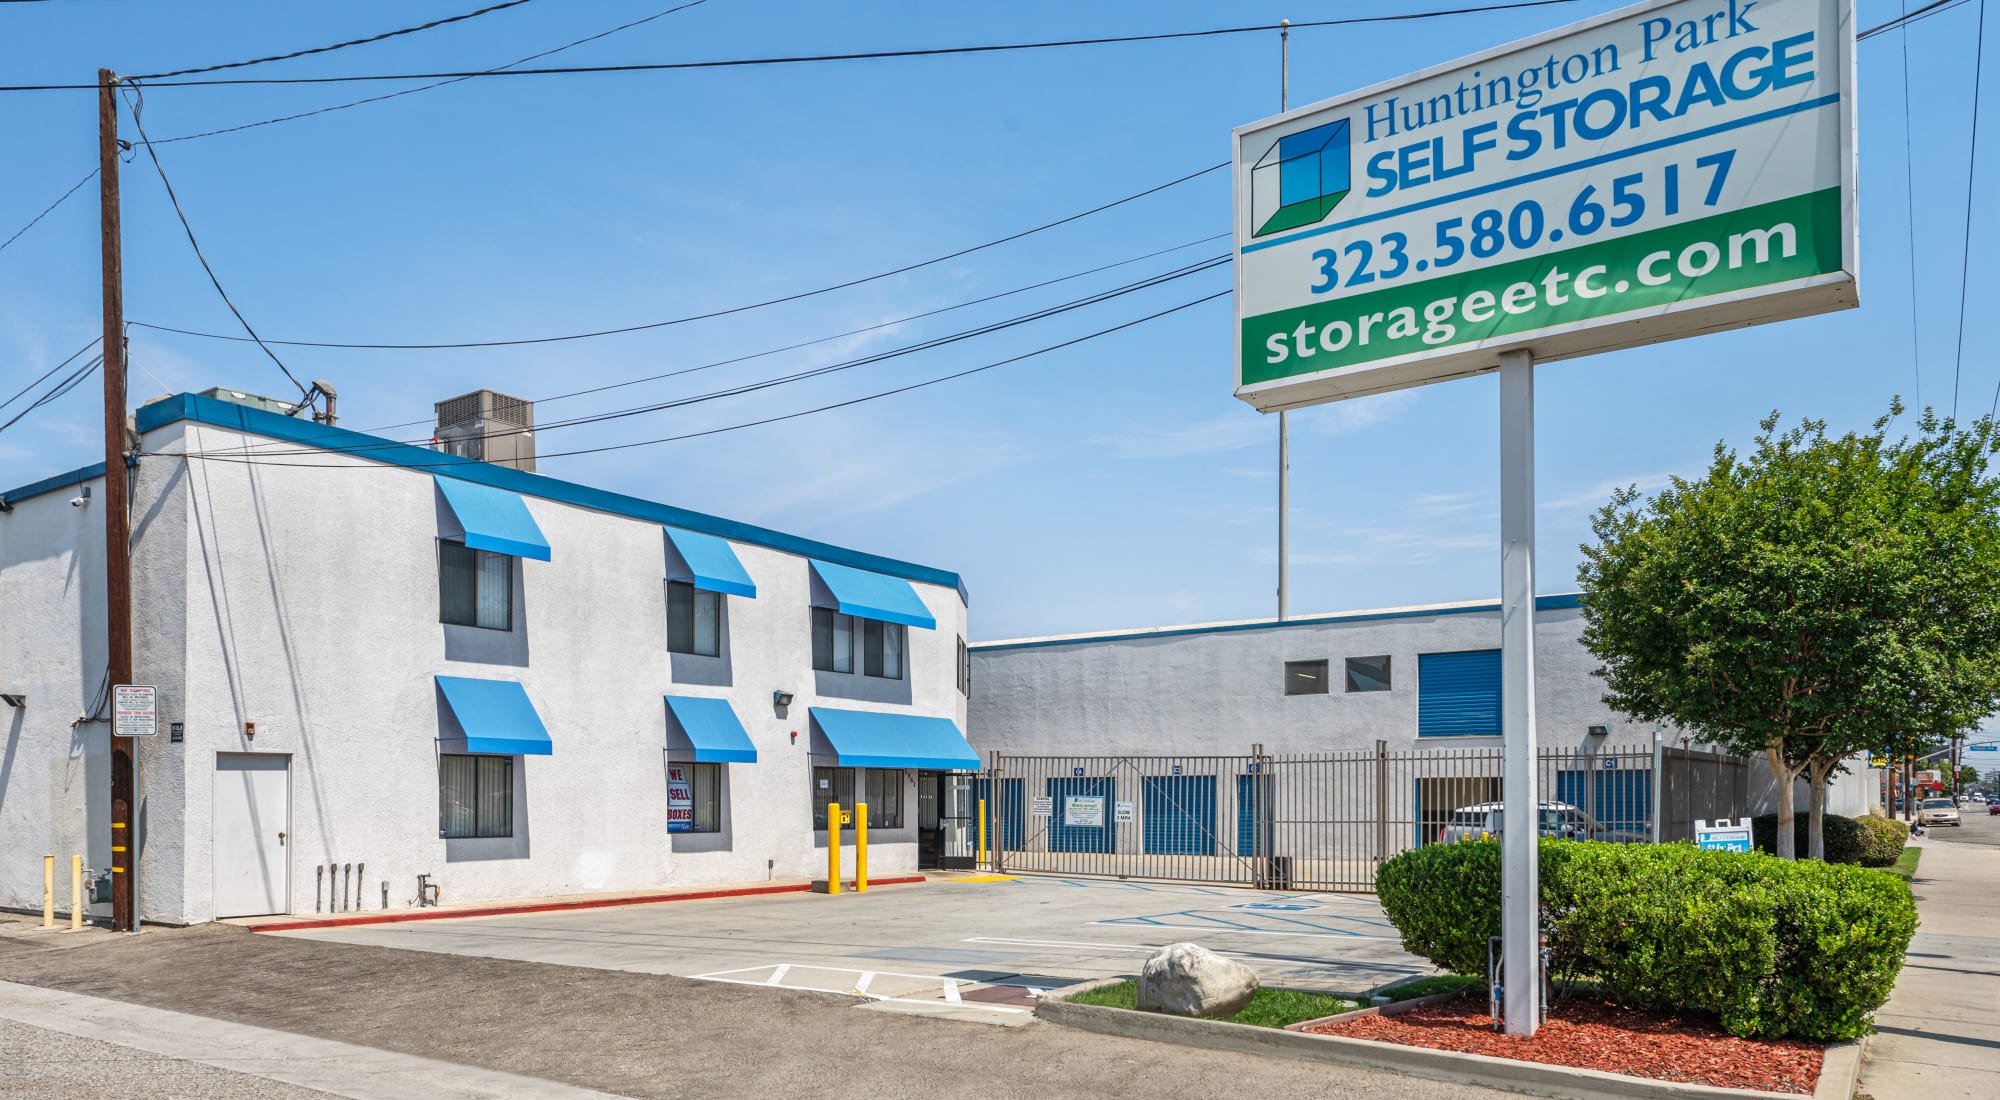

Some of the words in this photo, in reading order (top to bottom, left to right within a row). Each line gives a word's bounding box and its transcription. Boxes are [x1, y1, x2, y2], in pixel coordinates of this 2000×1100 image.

[1363, 43, 1621, 144] Huntington
[1639, 0, 1760, 64] Park
[1365, 121, 1498, 198] SELF
[1506, 31, 1816, 161] STORAGE
[1265, 221, 1797, 365] storageetc.com
[1310, 150, 1737, 294] 323.580.6517
[667, 809, 692, 820] BOXES
[669, 768, 683, 780] WE
[670, 788, 690, 800] SELL
